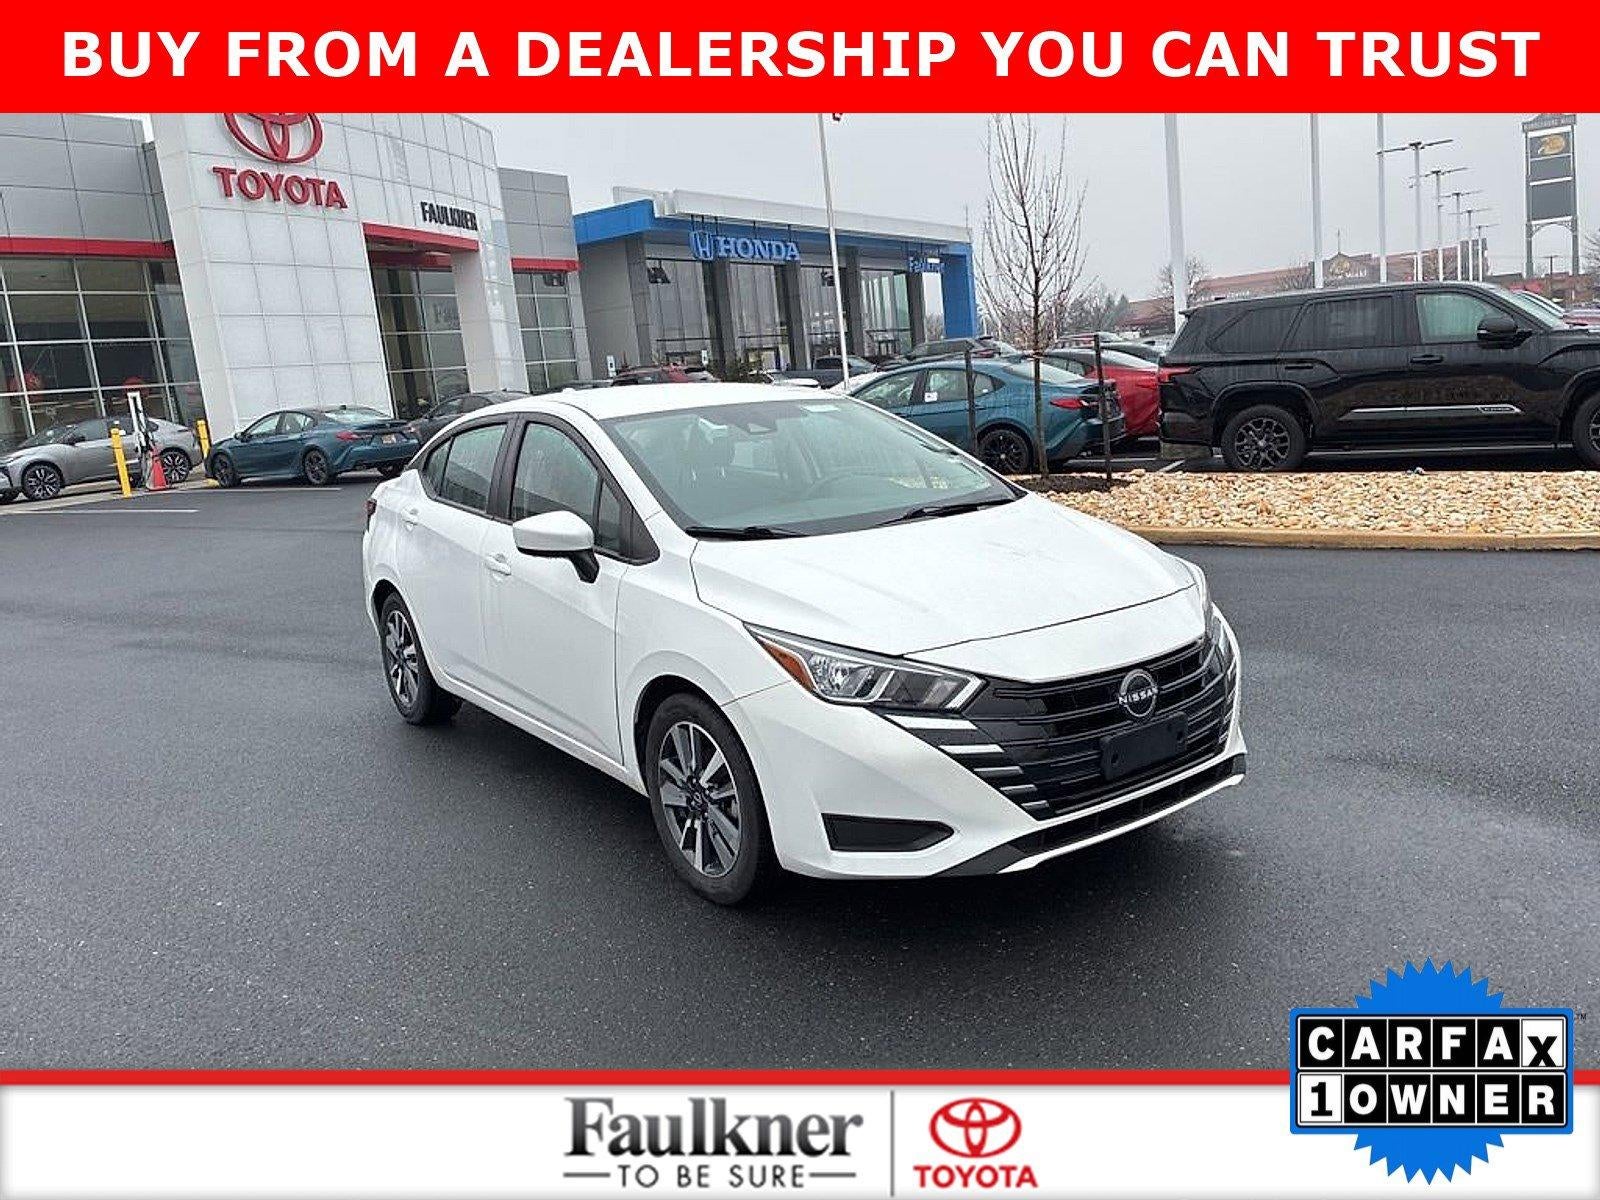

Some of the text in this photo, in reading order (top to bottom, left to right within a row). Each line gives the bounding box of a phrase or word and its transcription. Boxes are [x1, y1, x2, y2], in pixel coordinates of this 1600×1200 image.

[212, 166, 348, 209] TOYOTA
[420, 201, 478, 232] FAULKNER
[717, 235, 800, 261] HONDA
[1118, 686, 1159, 705] NISSAN
